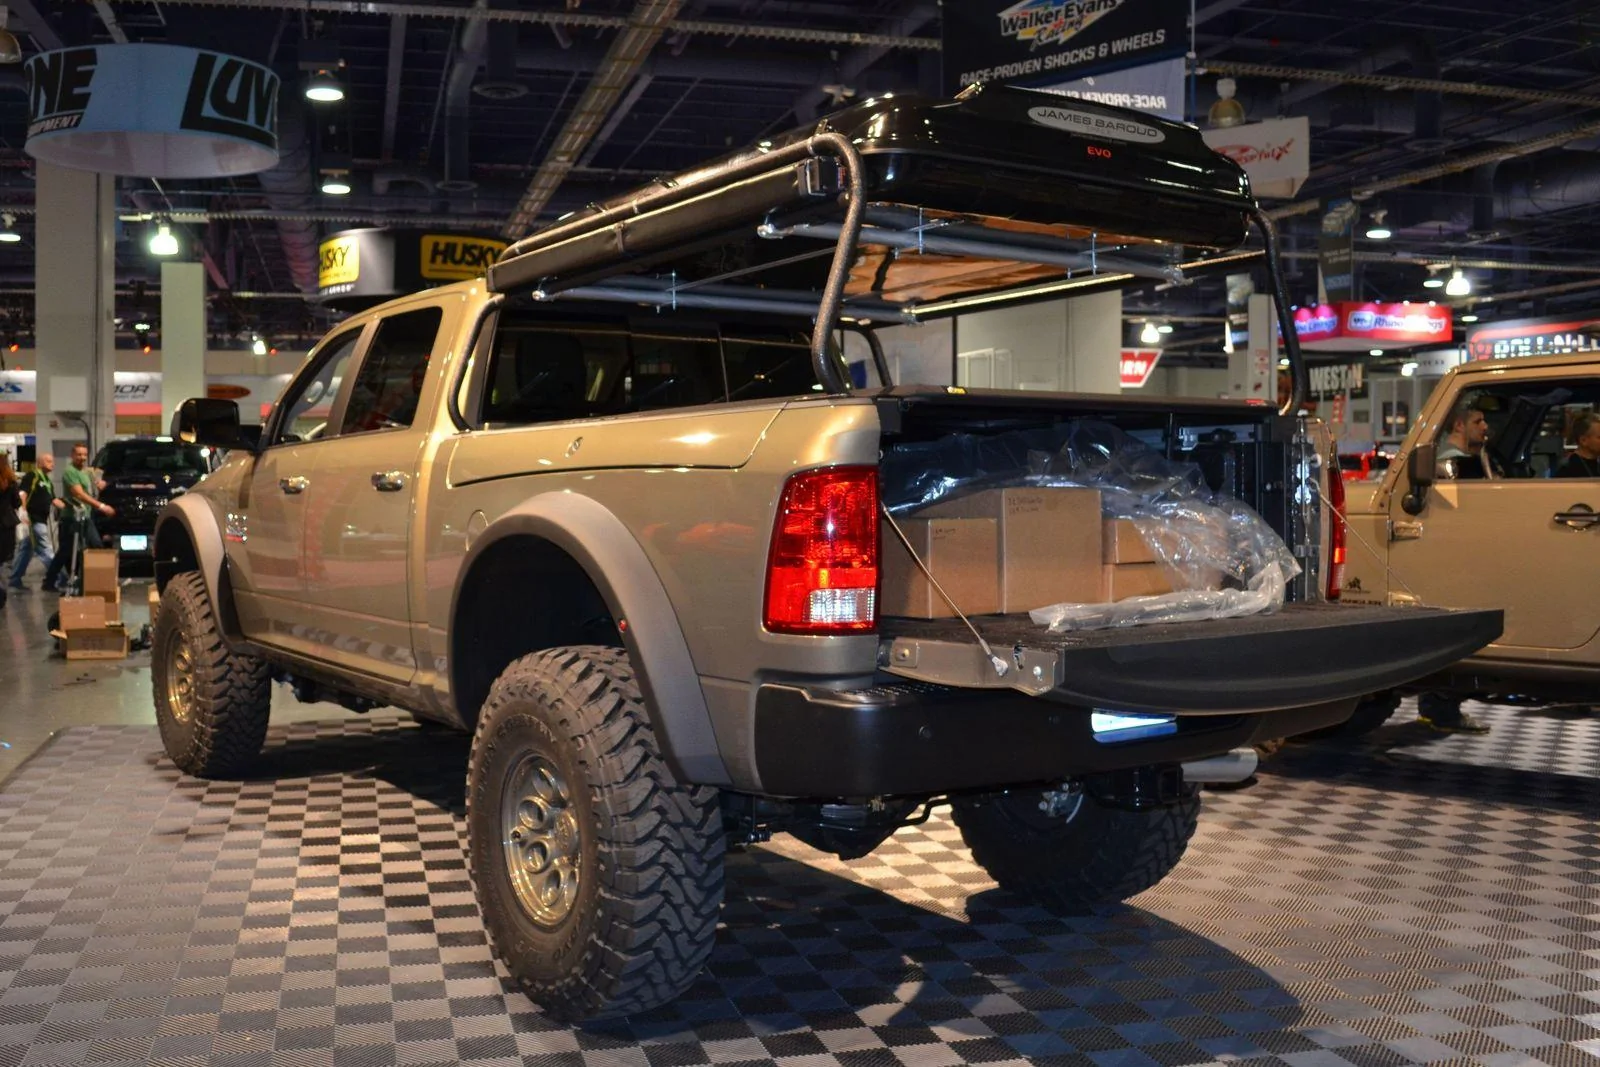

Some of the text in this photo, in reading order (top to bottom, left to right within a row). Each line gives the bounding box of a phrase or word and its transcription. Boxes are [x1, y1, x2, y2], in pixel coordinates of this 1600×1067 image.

[1000, 0, 1120, 35] Walker Evans
[960, 29, 1166, 87] RACE-PROVEN SHOCKS & WHEELS
[1037, 109, 1157, 137] JAMES BAROUD
[1087, 146, 1112, 159] EVO
